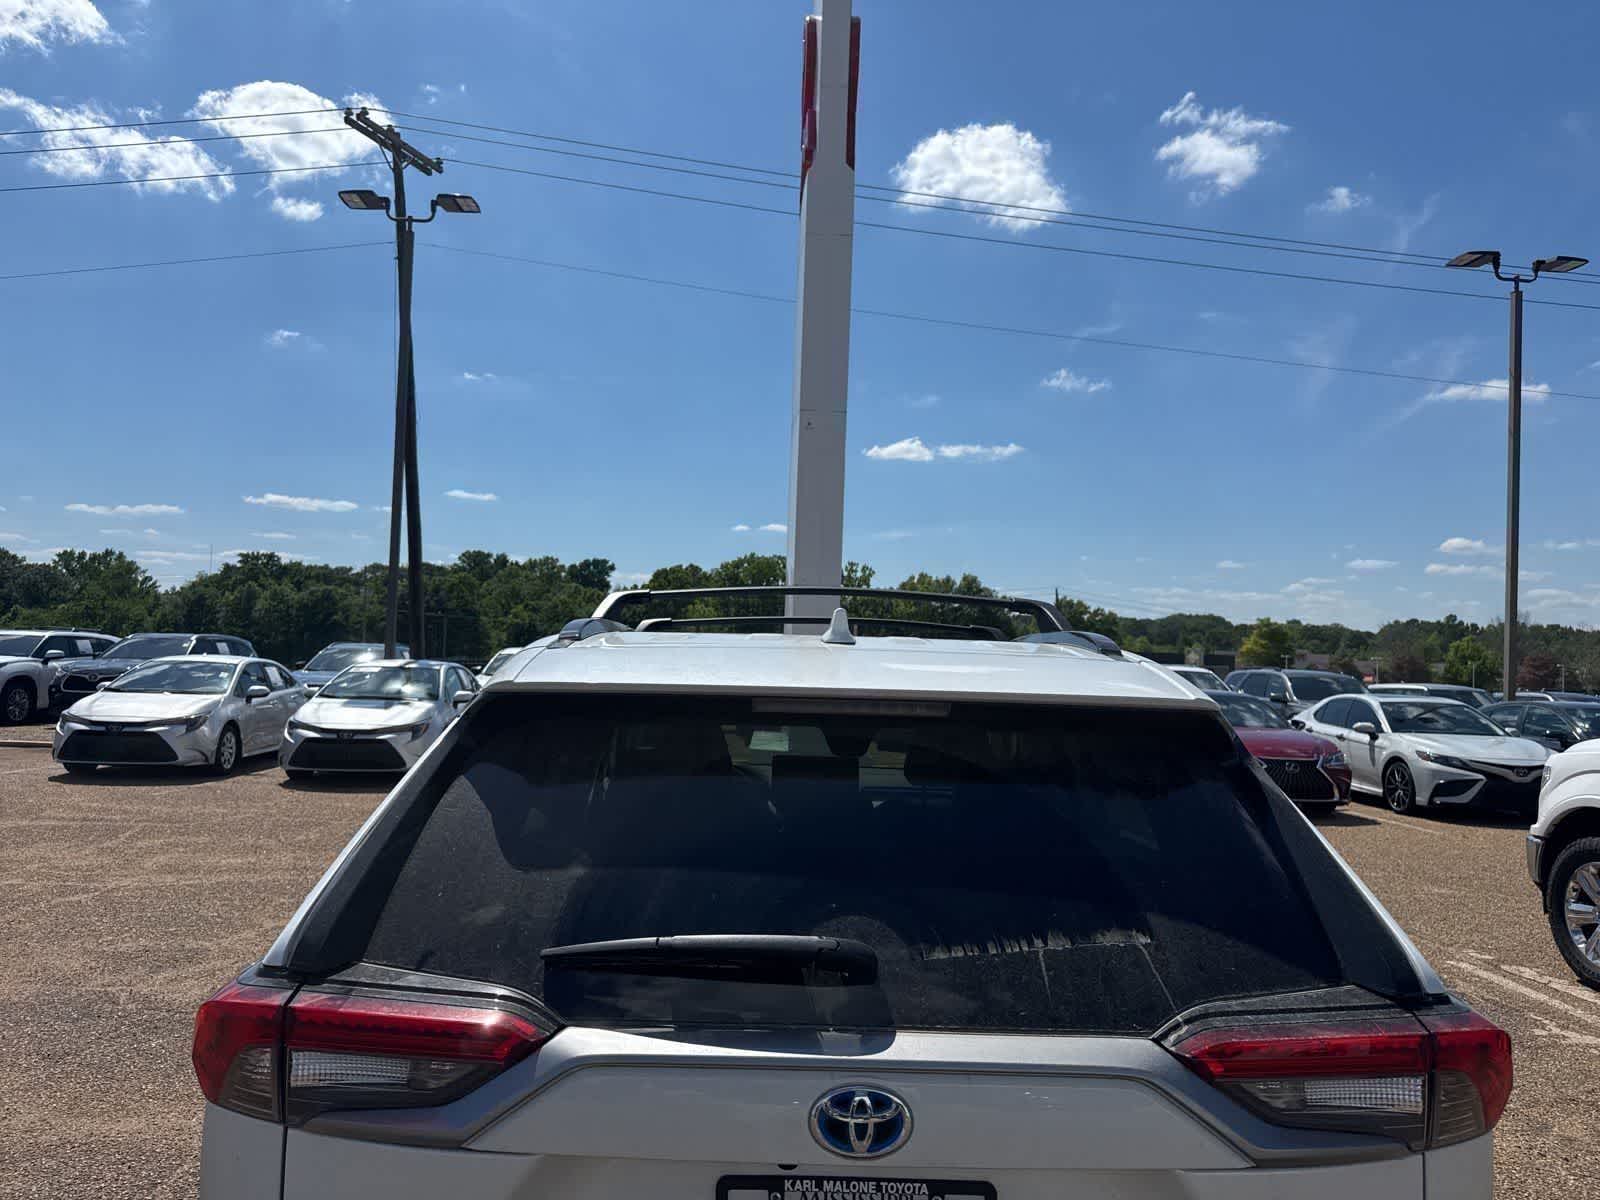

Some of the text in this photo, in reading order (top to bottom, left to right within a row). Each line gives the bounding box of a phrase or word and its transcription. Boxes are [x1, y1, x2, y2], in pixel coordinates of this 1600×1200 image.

[784, 1179, 928, 1195] KARL MALONE TOYOTA
